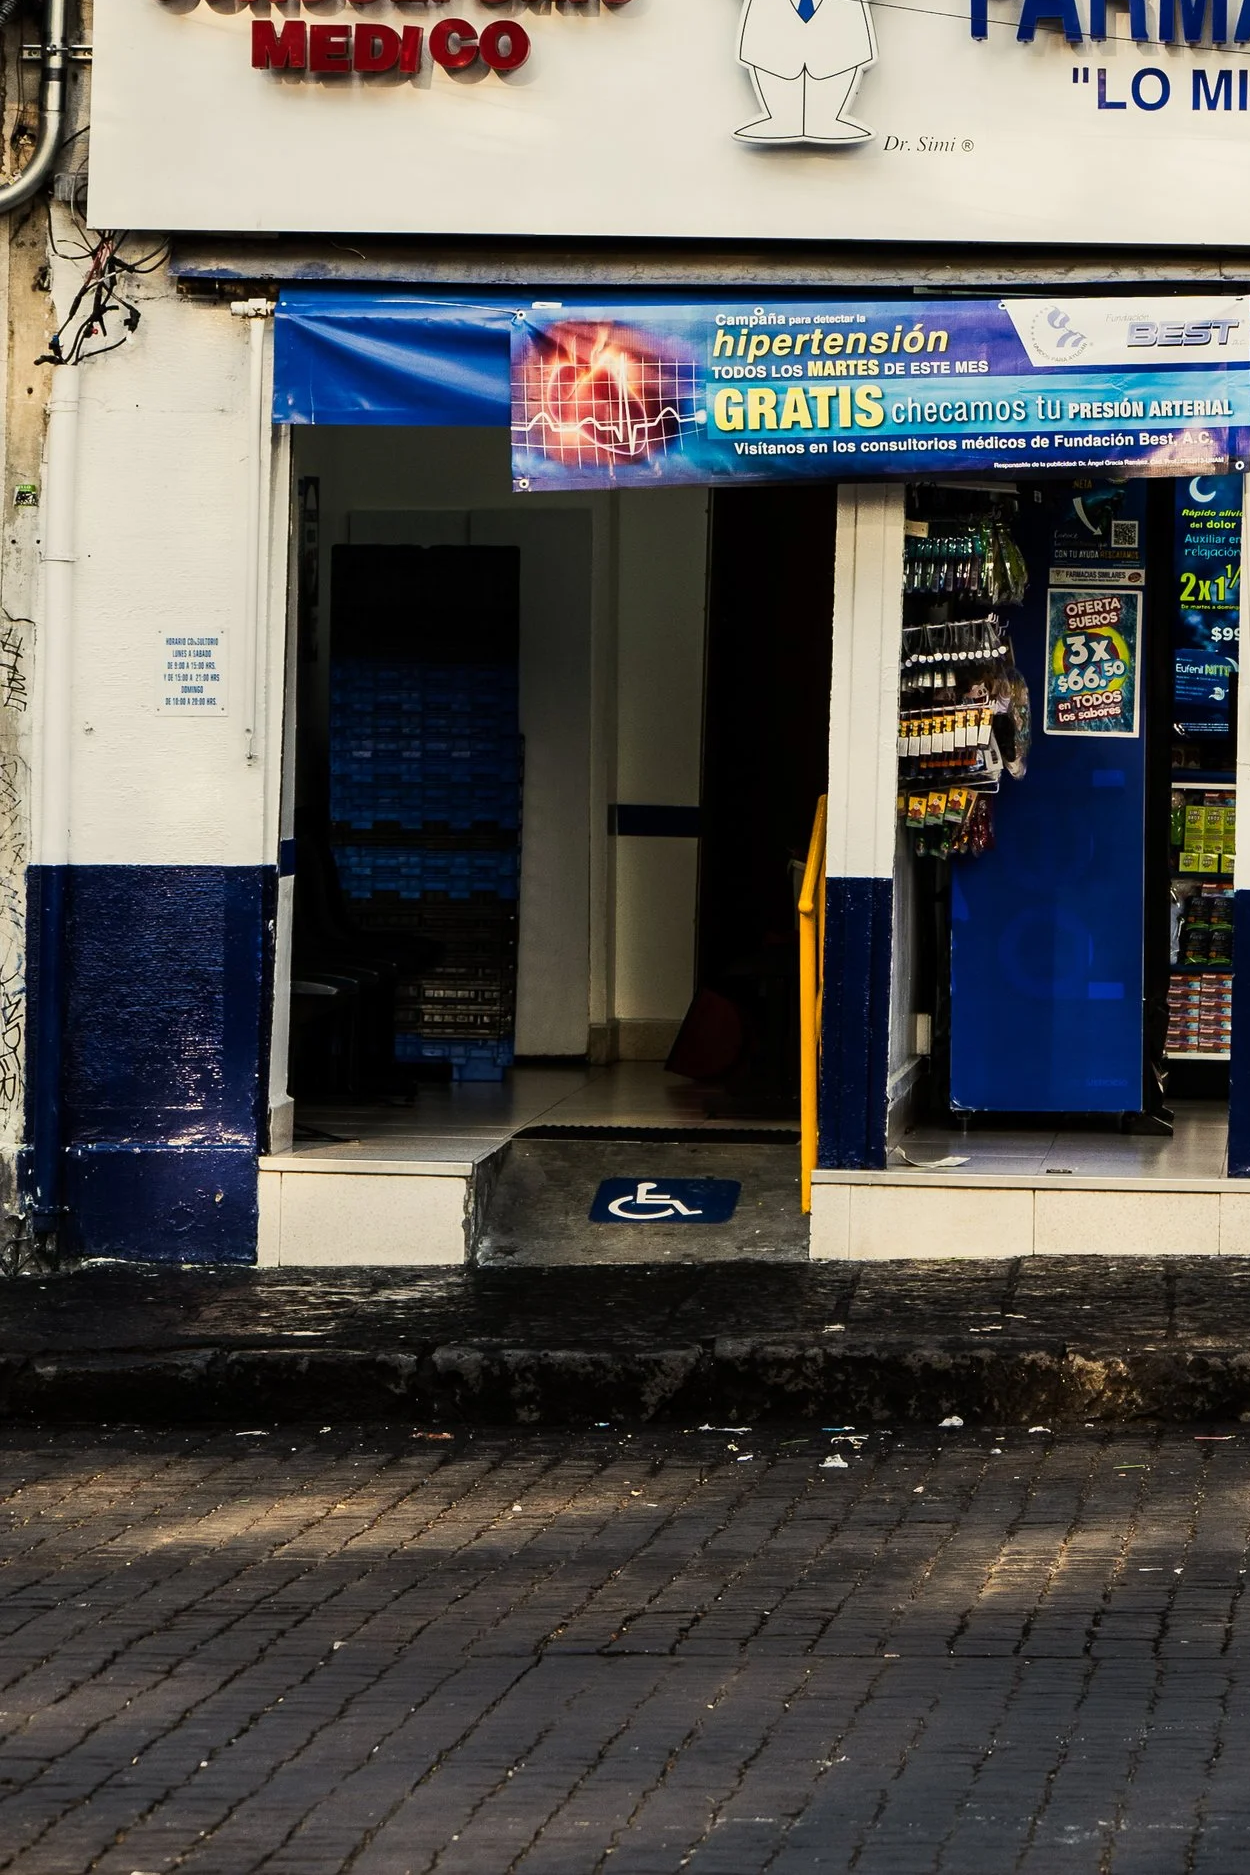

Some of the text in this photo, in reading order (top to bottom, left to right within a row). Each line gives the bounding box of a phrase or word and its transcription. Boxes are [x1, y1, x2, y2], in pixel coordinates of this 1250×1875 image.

[251, 17, 532, 74] MEDICO
[883, 135, 956, 152] Dr. Simi
[715, 312, 866, 328] Campaña para detectar la
[1127, 318, 1240, 348] BEST
[712, 323, 949, 364] hipertensión
[711, 359, 989, 379] TODOS LOS MARTES DE ESTE MES
[714, 384, 1234, 432] GRATIS checamos tu PRESIÓN ARTERIAL
[734, 441, 805, 455] Visítanos
[809, 443, 828, 453] en
[833, 440, 856, 452] los
[860, 437, 958, 452] consultorios
[961, 436, 1026, 450] médicos
[1030, 435, 1050, 448] de
[1054, 433, 1135, 447] Fundación
[1182, 432, 1214, 445] A.C.
[1181, 508, 1217, 518] Rápido
[1206, 519, 1237, 529] dolor
[1184, 533, 1226, 544] Auxiliar
[1054, 549, 1068, 558] CON
[1069, 549, 1078, 558] TU
[1079, 549, 1099, 559] AYUDA
[1184, 545, 1242, 560] relajación
[1065, 570, 1127, 579] FARMACIAS SIMILARES
[1066, 597, 1121, 616] OFERTA
[1068, 612, 1119, 629] SUEROS
[1058, 690, 1123, 711] en TODOS
[1058, 706, 1121, 722] los sabores
